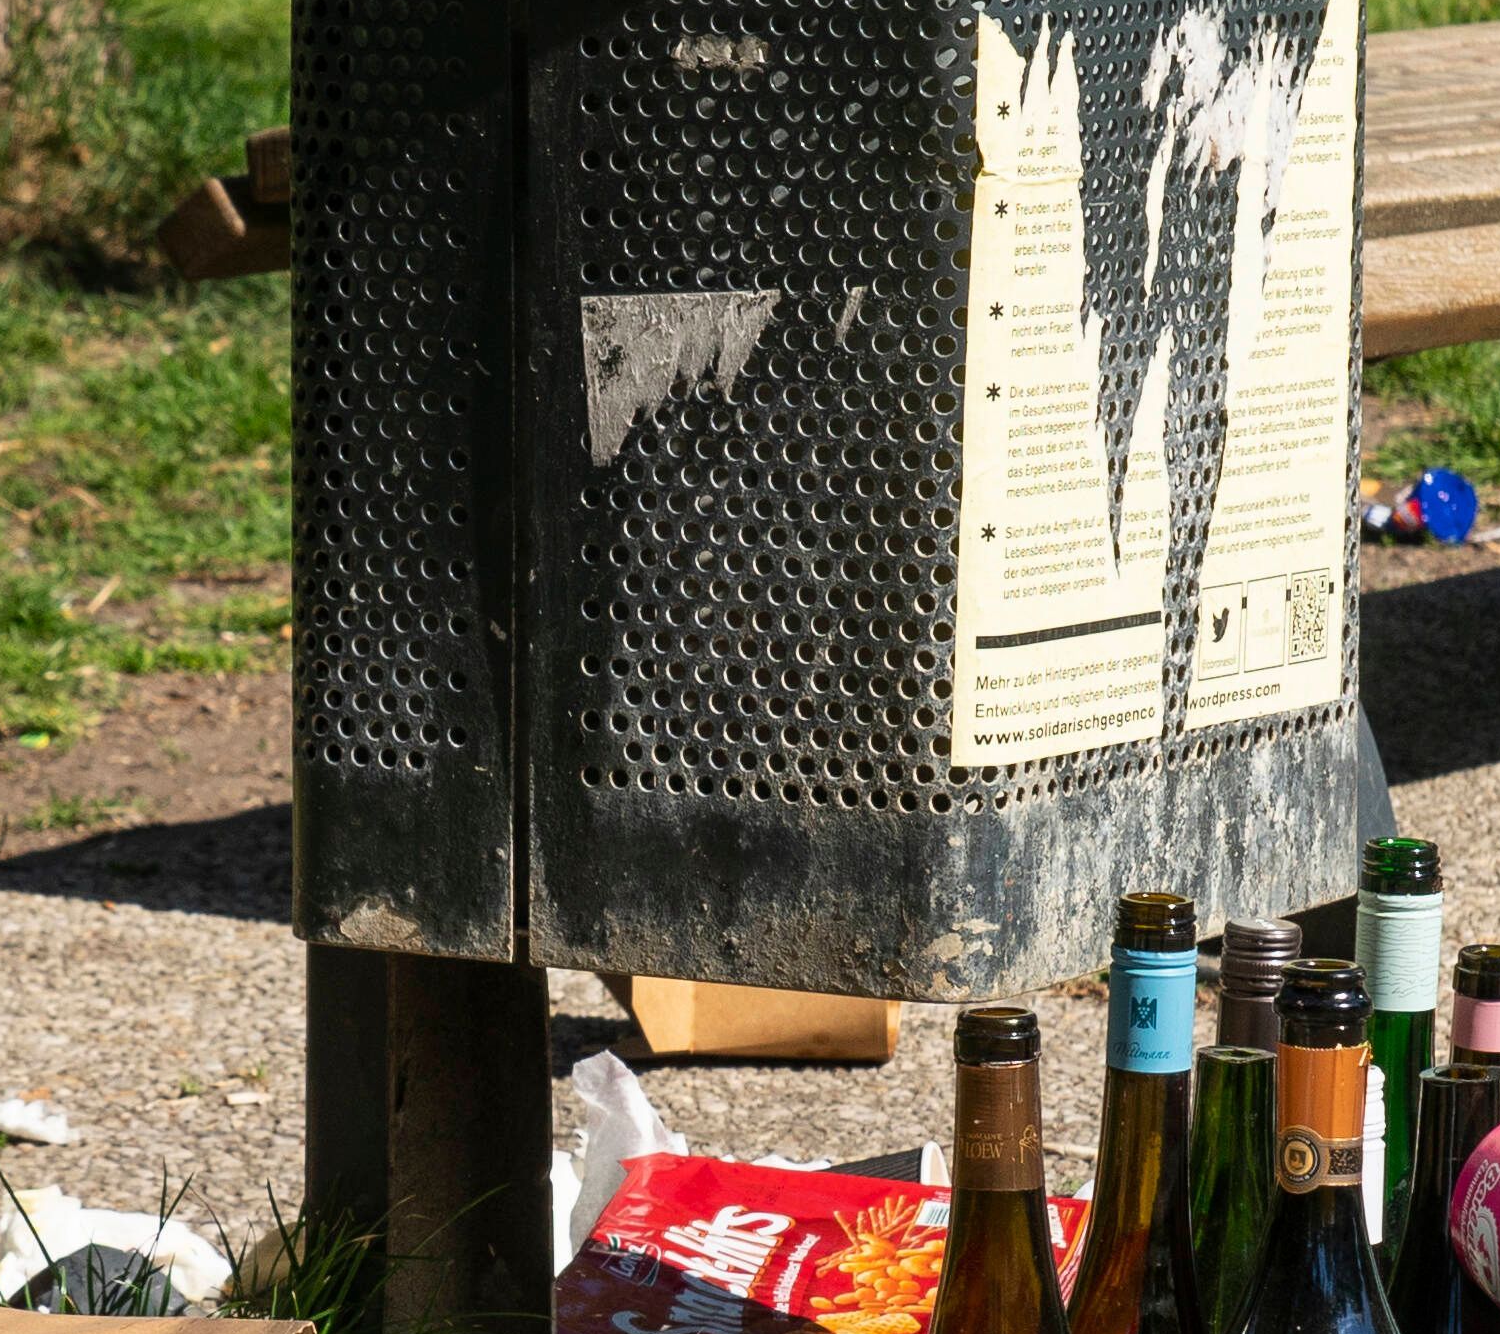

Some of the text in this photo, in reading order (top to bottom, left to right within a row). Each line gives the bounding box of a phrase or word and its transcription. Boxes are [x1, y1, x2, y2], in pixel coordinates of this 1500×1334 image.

[1015, 202, 1051, 215] Freunden
[1009, 385, 1024, 399] Die
[1007, 467, 1024, 479] das
[1025, 462, 1058, 477] Ergebnis
[1005, 523, 1025, 540] Sich
[1003, 566, 1019, 580] der
[1003, 587, 1020, 600] und
[975, 675, 1011, 691] Mehr
[1013, 675, 1026, 689] zu
[1026, 671, 1043, 686] den
[1189, 682, 1281, 710] wordpress.com
[975, 695, 1043, 718] Entwicklung
[1043, 695, 1060, 709] und
